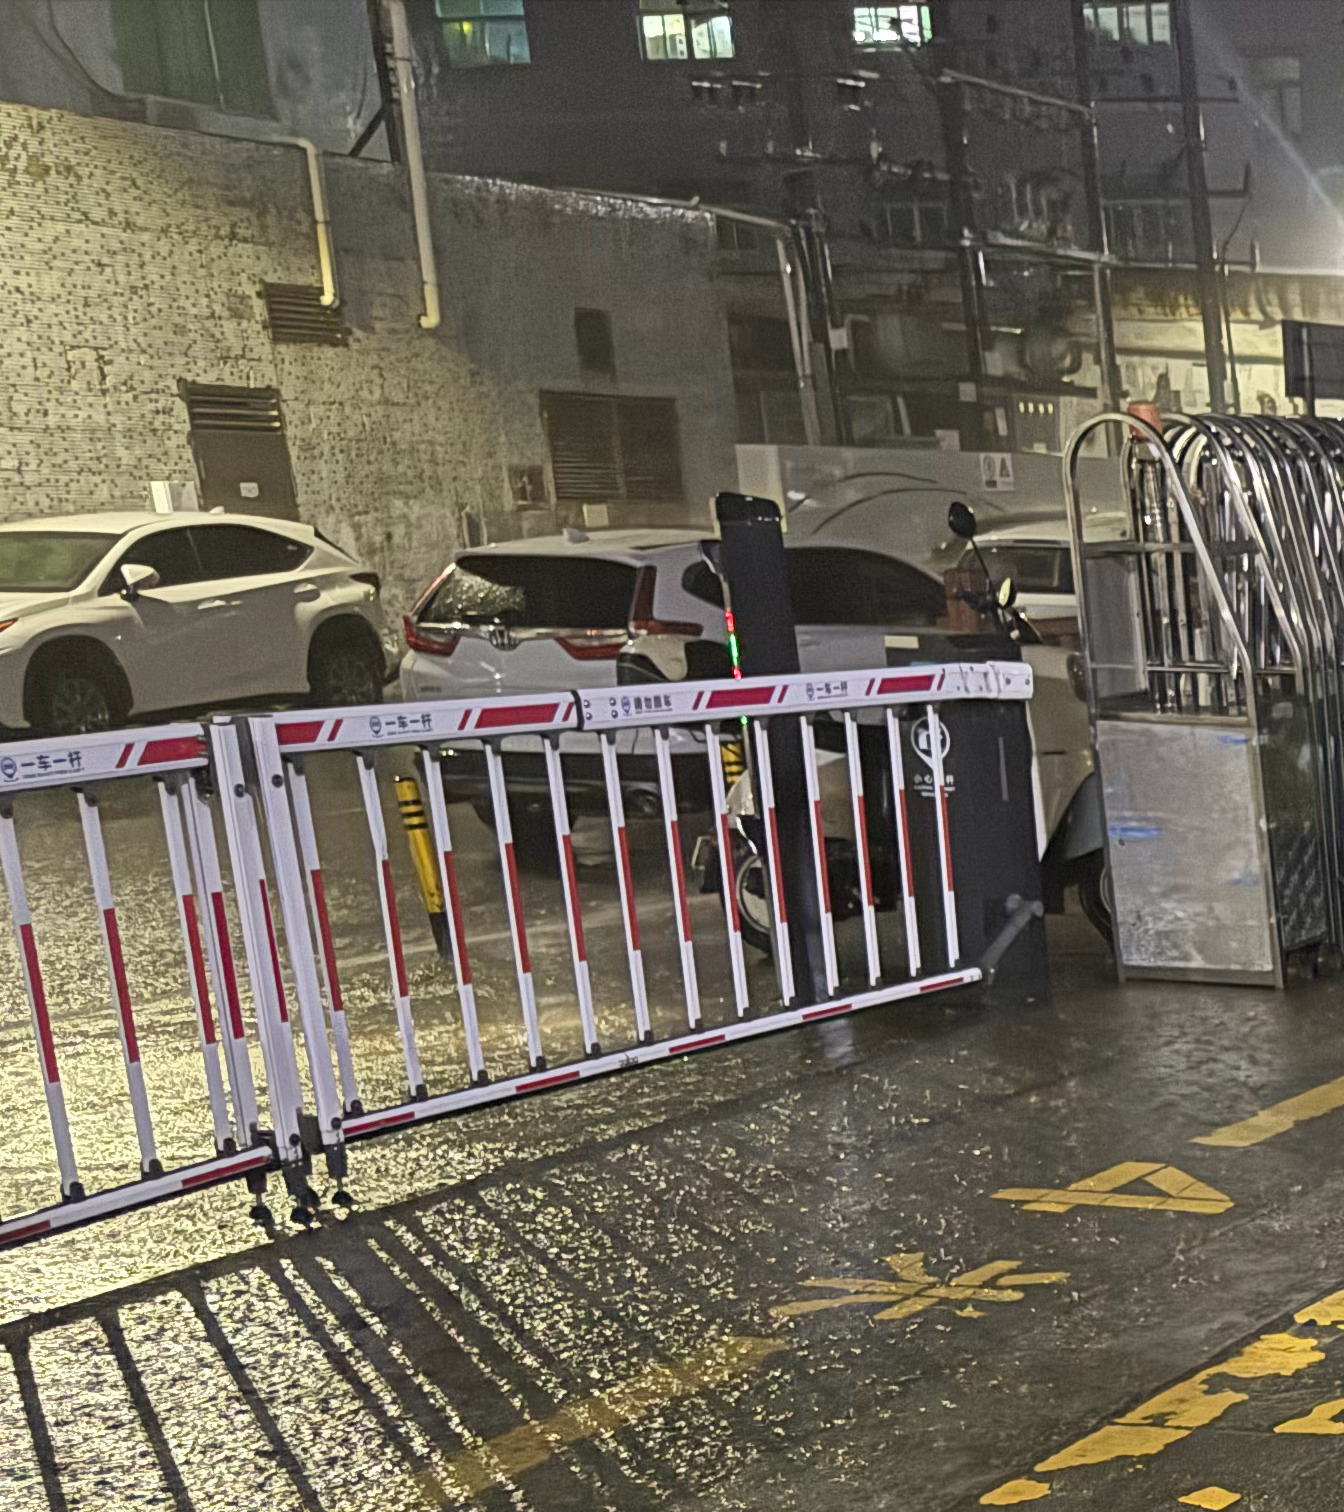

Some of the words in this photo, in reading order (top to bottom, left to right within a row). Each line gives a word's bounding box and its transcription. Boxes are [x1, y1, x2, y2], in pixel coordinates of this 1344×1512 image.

[385, 713, 432, 730] 一车一杆
[21, 750, 83, 771] 一车一杆
